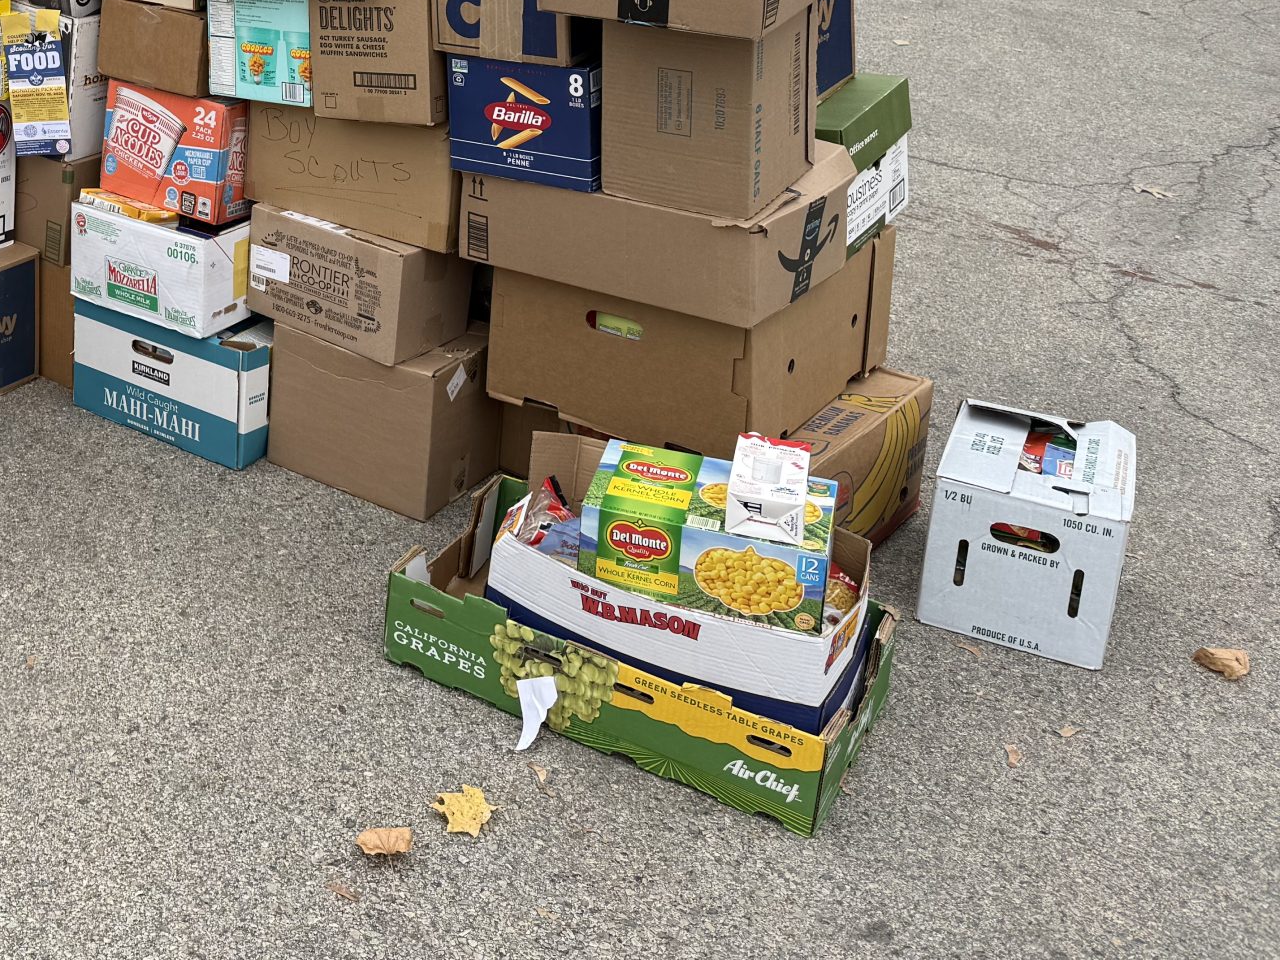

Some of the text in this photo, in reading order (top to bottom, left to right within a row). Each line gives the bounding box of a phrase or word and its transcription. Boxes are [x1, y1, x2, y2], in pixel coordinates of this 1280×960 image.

[319, 6, 394, 32] DELIGHTS
[356, 36, 388, 44] SAUSAGE,
[8, 51, 61, 71] FOOD
[569, 74, 584, 97] 8
[193, 106, 217, 128] 24
[493, 107, 543, 126] Barilla
[127, 118, 161, 146] CUP
[192, 132, 215, 143] 2.25 OZ
[195, 126, 213, 135] PACK
[113, 128, 165, 169] NOODLES
[849, 129, 878, 156] Office DEPOT
[113, 148, 143, 170] CHICKEN
[188, 157, 201, 166] PAPER
[284, 150, 411, 183] SCOUTS
[507, 158, 530, 167] PENNE
[753, 119, 762, 204] HALF GALS.
[108, 259, 158, 296] MOZZARELLA
[289, 254, 350, 288] RONTIER
[301, 274, 332, 291] CO-OP
[114, 288, 151, 306] WHOLE MILK
[322, 293, 336, 302] SINCE
[134, 362, 169, 381] KIRKLAND
[126, 385, 179, 413] Wild Caught
[104, 387, 201, 442] MAHI-MAHI
[803, 406, 846, 433] PREMIUM
[823, 412, 866, 436] BANANAS
[629, 462, 687, 480] Del Monte
[613, 485, 685, 504] KERNEL CORN
[637, 483, 677, 496] WHOLE
[944, 489, 973, 505] 1/2 BU
[1063, 518, 1115, 539] 1050 CU. IN.
[613, 529, 667, 550] Del Monte
[627, 545, 650, 556] Quality
[981, 542, 1060, 569] GROWN & PACKED BY
[801, 558, 819, 573] 12
[598, 566, 676, 589] WHOLE KERNEL CORN
[801, 572, 820, 582] CANS
[571, 579, 607, 599] WHO BUT
[395, 620, 487, 666] CALIFORNIA
[971, 625, 1042, 652] PRODUCE OF U.S.A.
[394, 631, 486, 679] GRAPES
[634, 676, 804, 746] GREEN SEEDLESS TABLE GRAPES
